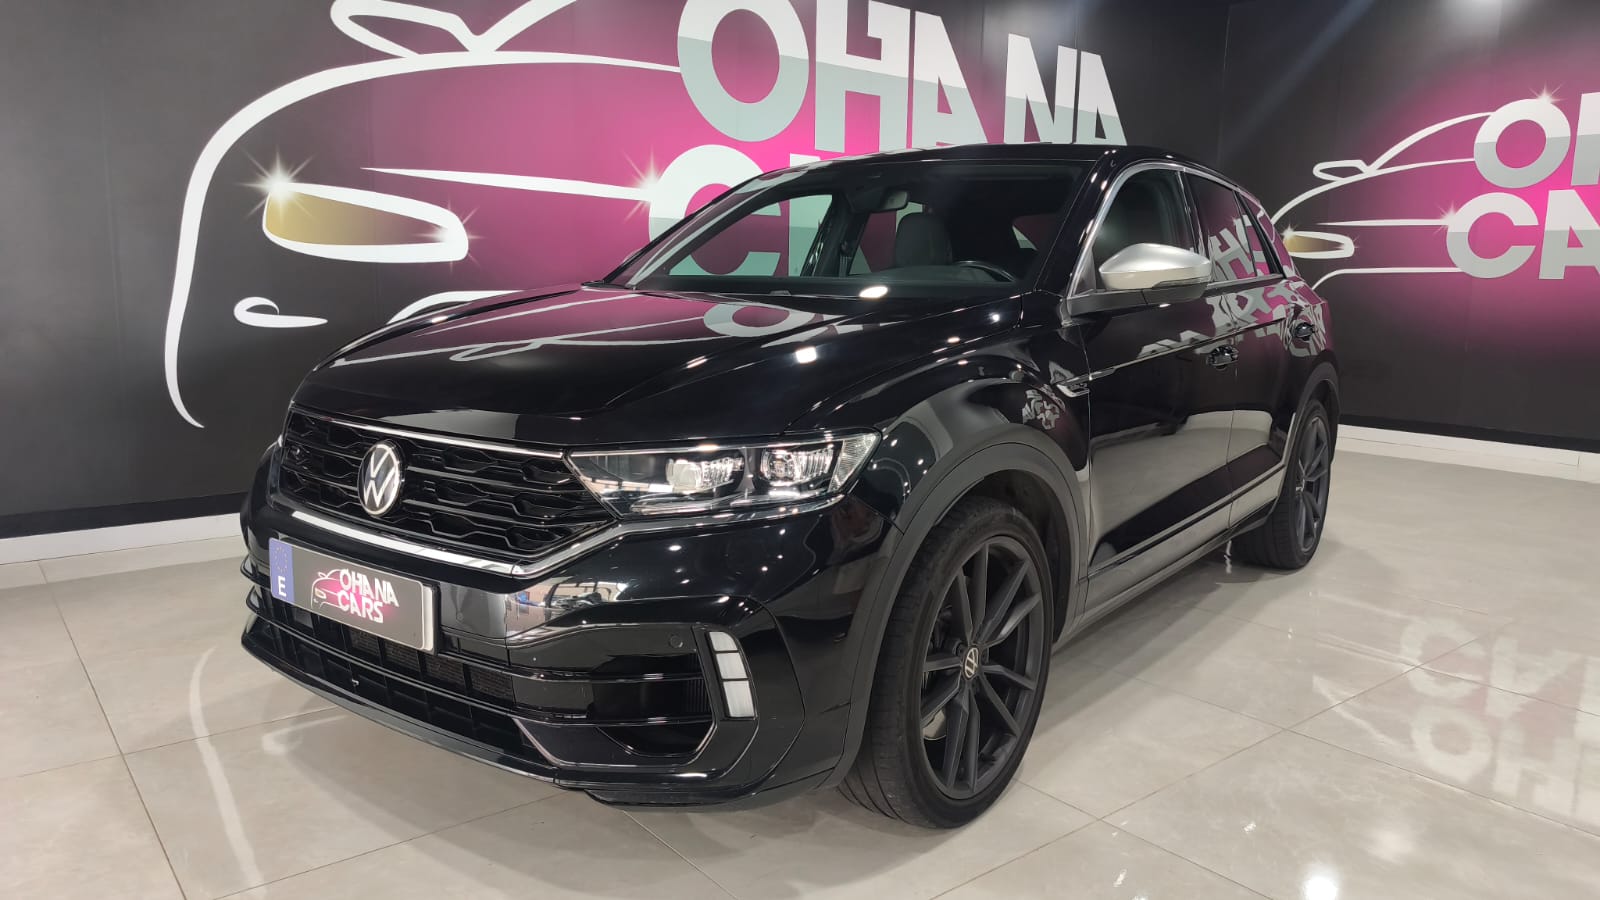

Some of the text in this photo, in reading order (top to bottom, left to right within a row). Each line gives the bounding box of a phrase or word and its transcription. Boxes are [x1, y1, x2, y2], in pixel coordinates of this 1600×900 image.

[677, 0, 1128, 153] OHANA
[278, 576, 287, 597] E
[340, 568, 400, 608] OHANA
[337, 589, 384, 624] CARS
